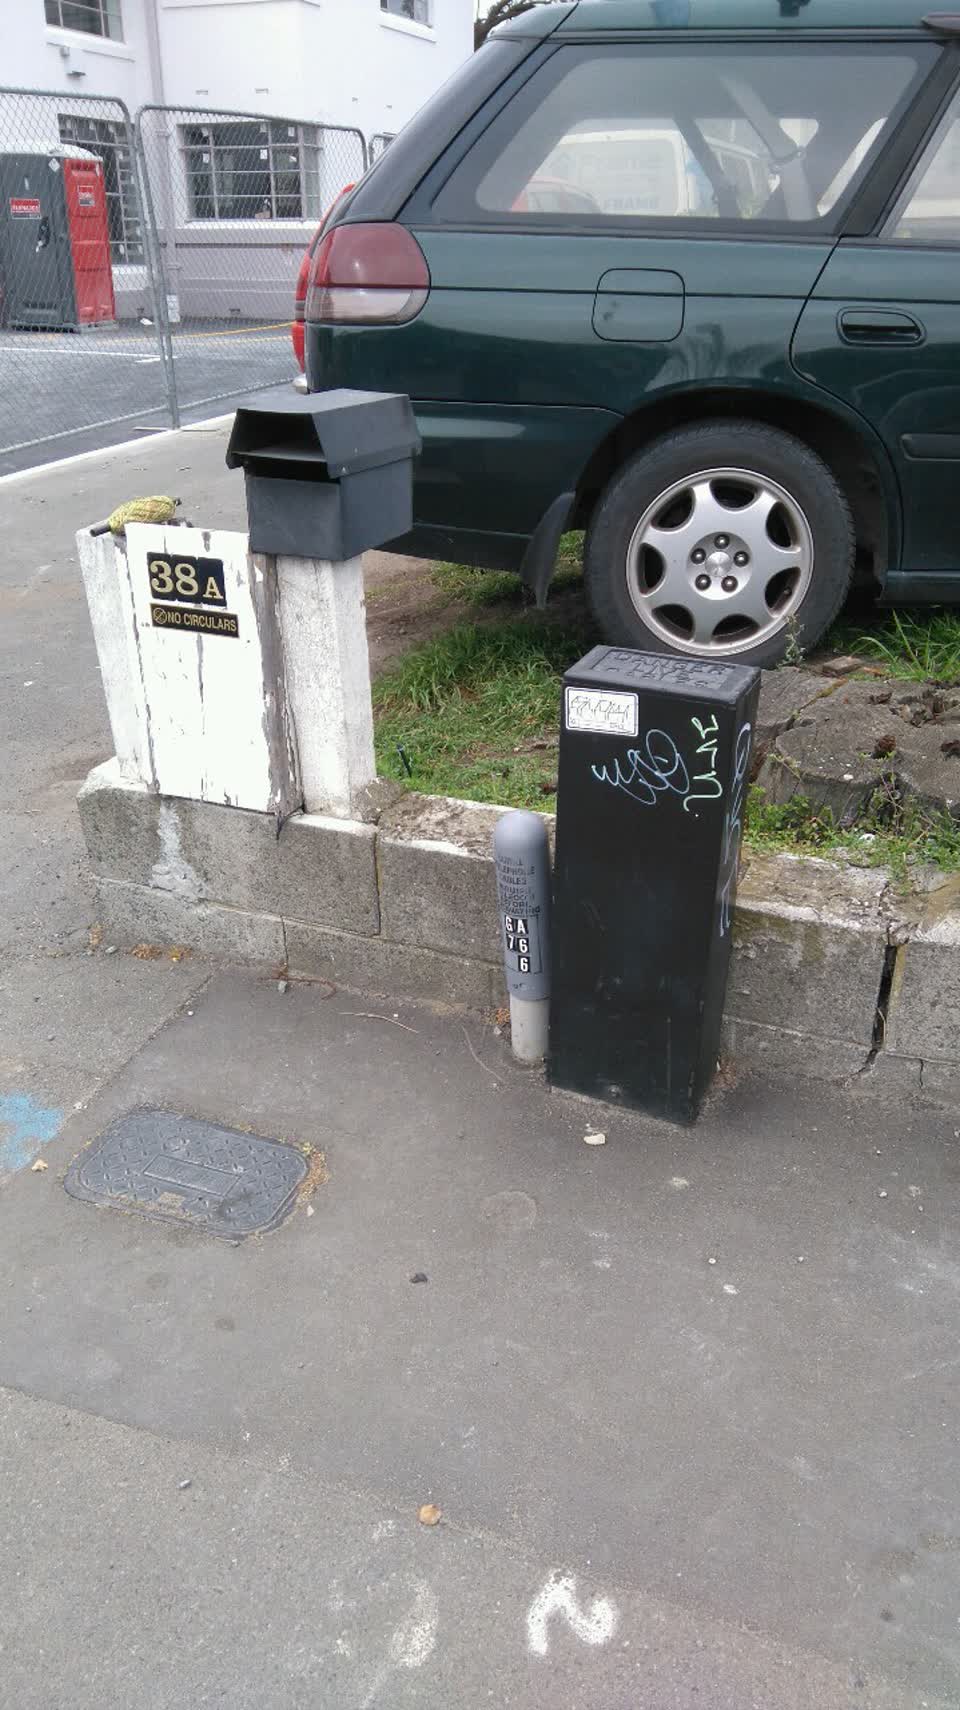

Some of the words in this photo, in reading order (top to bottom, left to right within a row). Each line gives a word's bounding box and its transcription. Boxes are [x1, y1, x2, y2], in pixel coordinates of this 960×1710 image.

[167, 611, 181, 624] NO
[184, 613, 237, 632] CIRCULARS
[617, 652, 725, 675] DANGER
[507, 935, 528, 953] 76
[520, 957, 529, 972] 6
